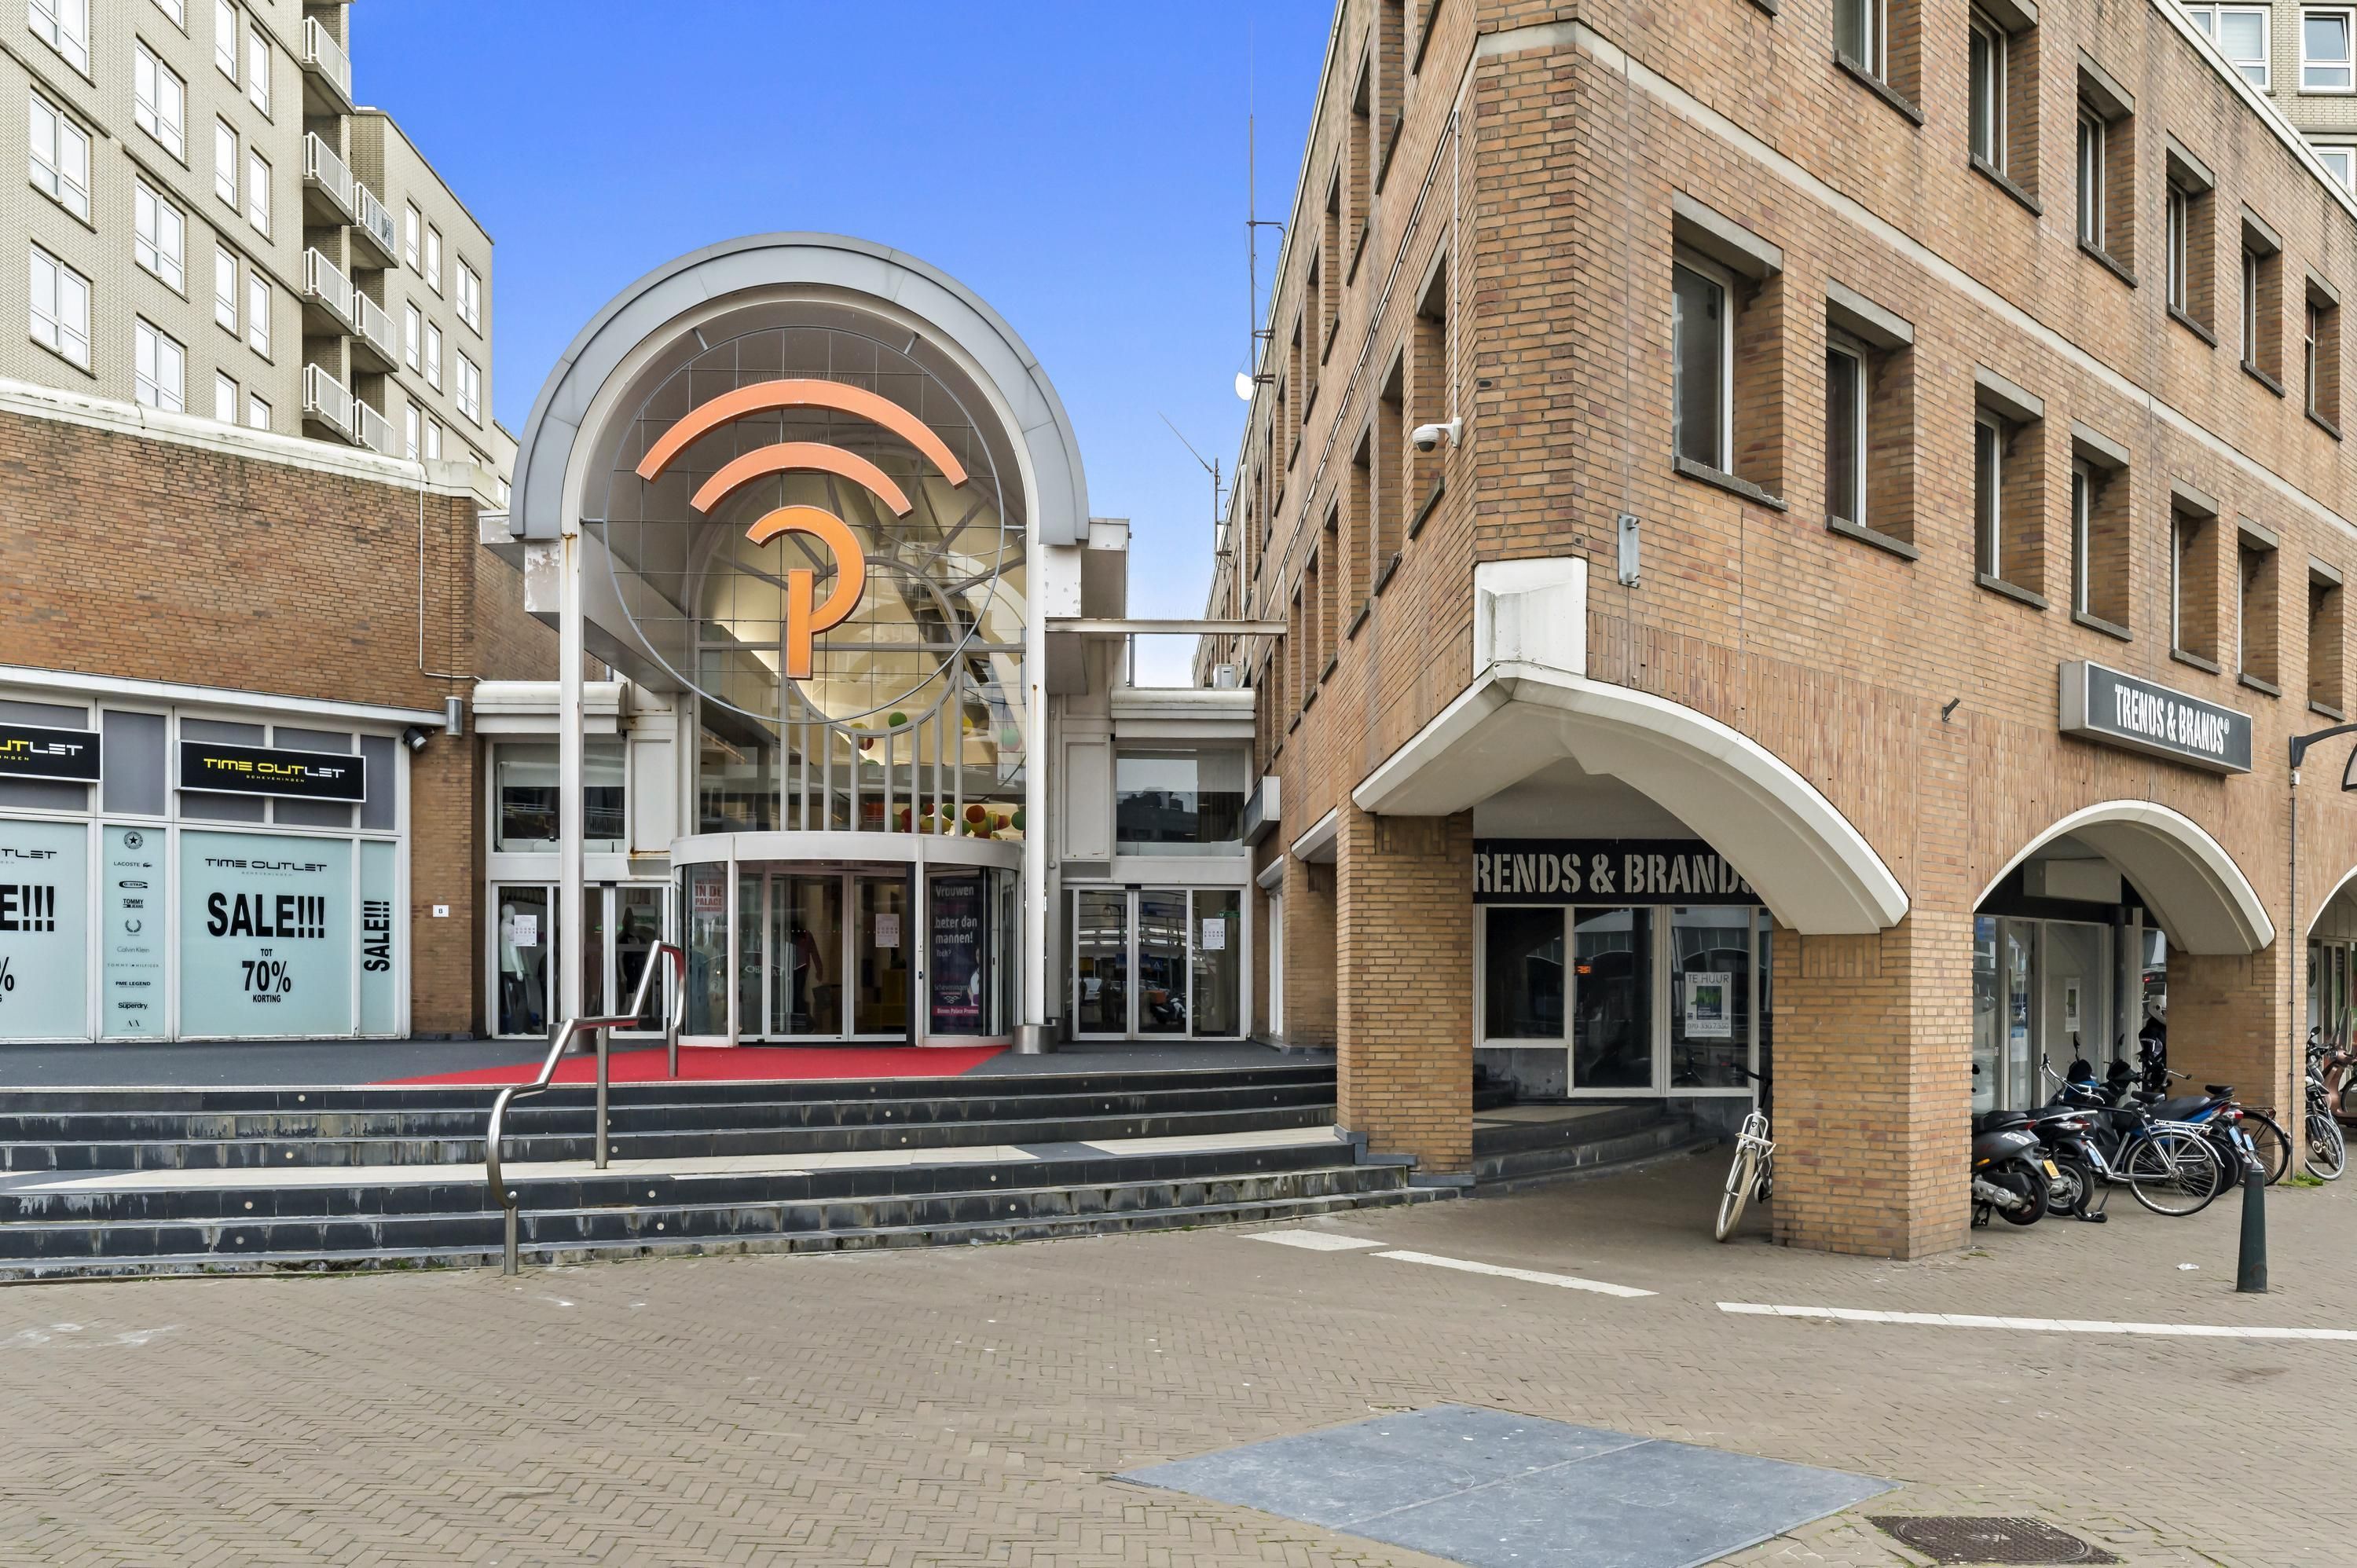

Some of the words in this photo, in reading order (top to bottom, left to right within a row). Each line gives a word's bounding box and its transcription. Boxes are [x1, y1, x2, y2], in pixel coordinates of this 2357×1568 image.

[2115, 683, 2165, 738] TRENDS
[2167, 701, 2177, 742] &
[203, 758, 253, 771] TIME
[258, 763, 345, 779] OUTLET
[205, 858, 247, 868] TIME
[251, 861, 327, 872] OUTLET
[1589, 854, 1616, 893] &
[935, 885, 974, 896] Vrouwen
[207, 892, 324, 939] SALE!!!
[935, 916, 959, 928] beter
[961, 915, 977, 927] dan
[364, 900, 390, 972] SALE!!!
[936, 932, 973, 943] mannen!
[260, 948, 273, 957] TOT
[242, 960, 291, 993] 70%
[1688, 974, 1697, 983] TE
[1702, 974, 1729, 983] HUUR
[252, 995, 281, 1003] KORTING
